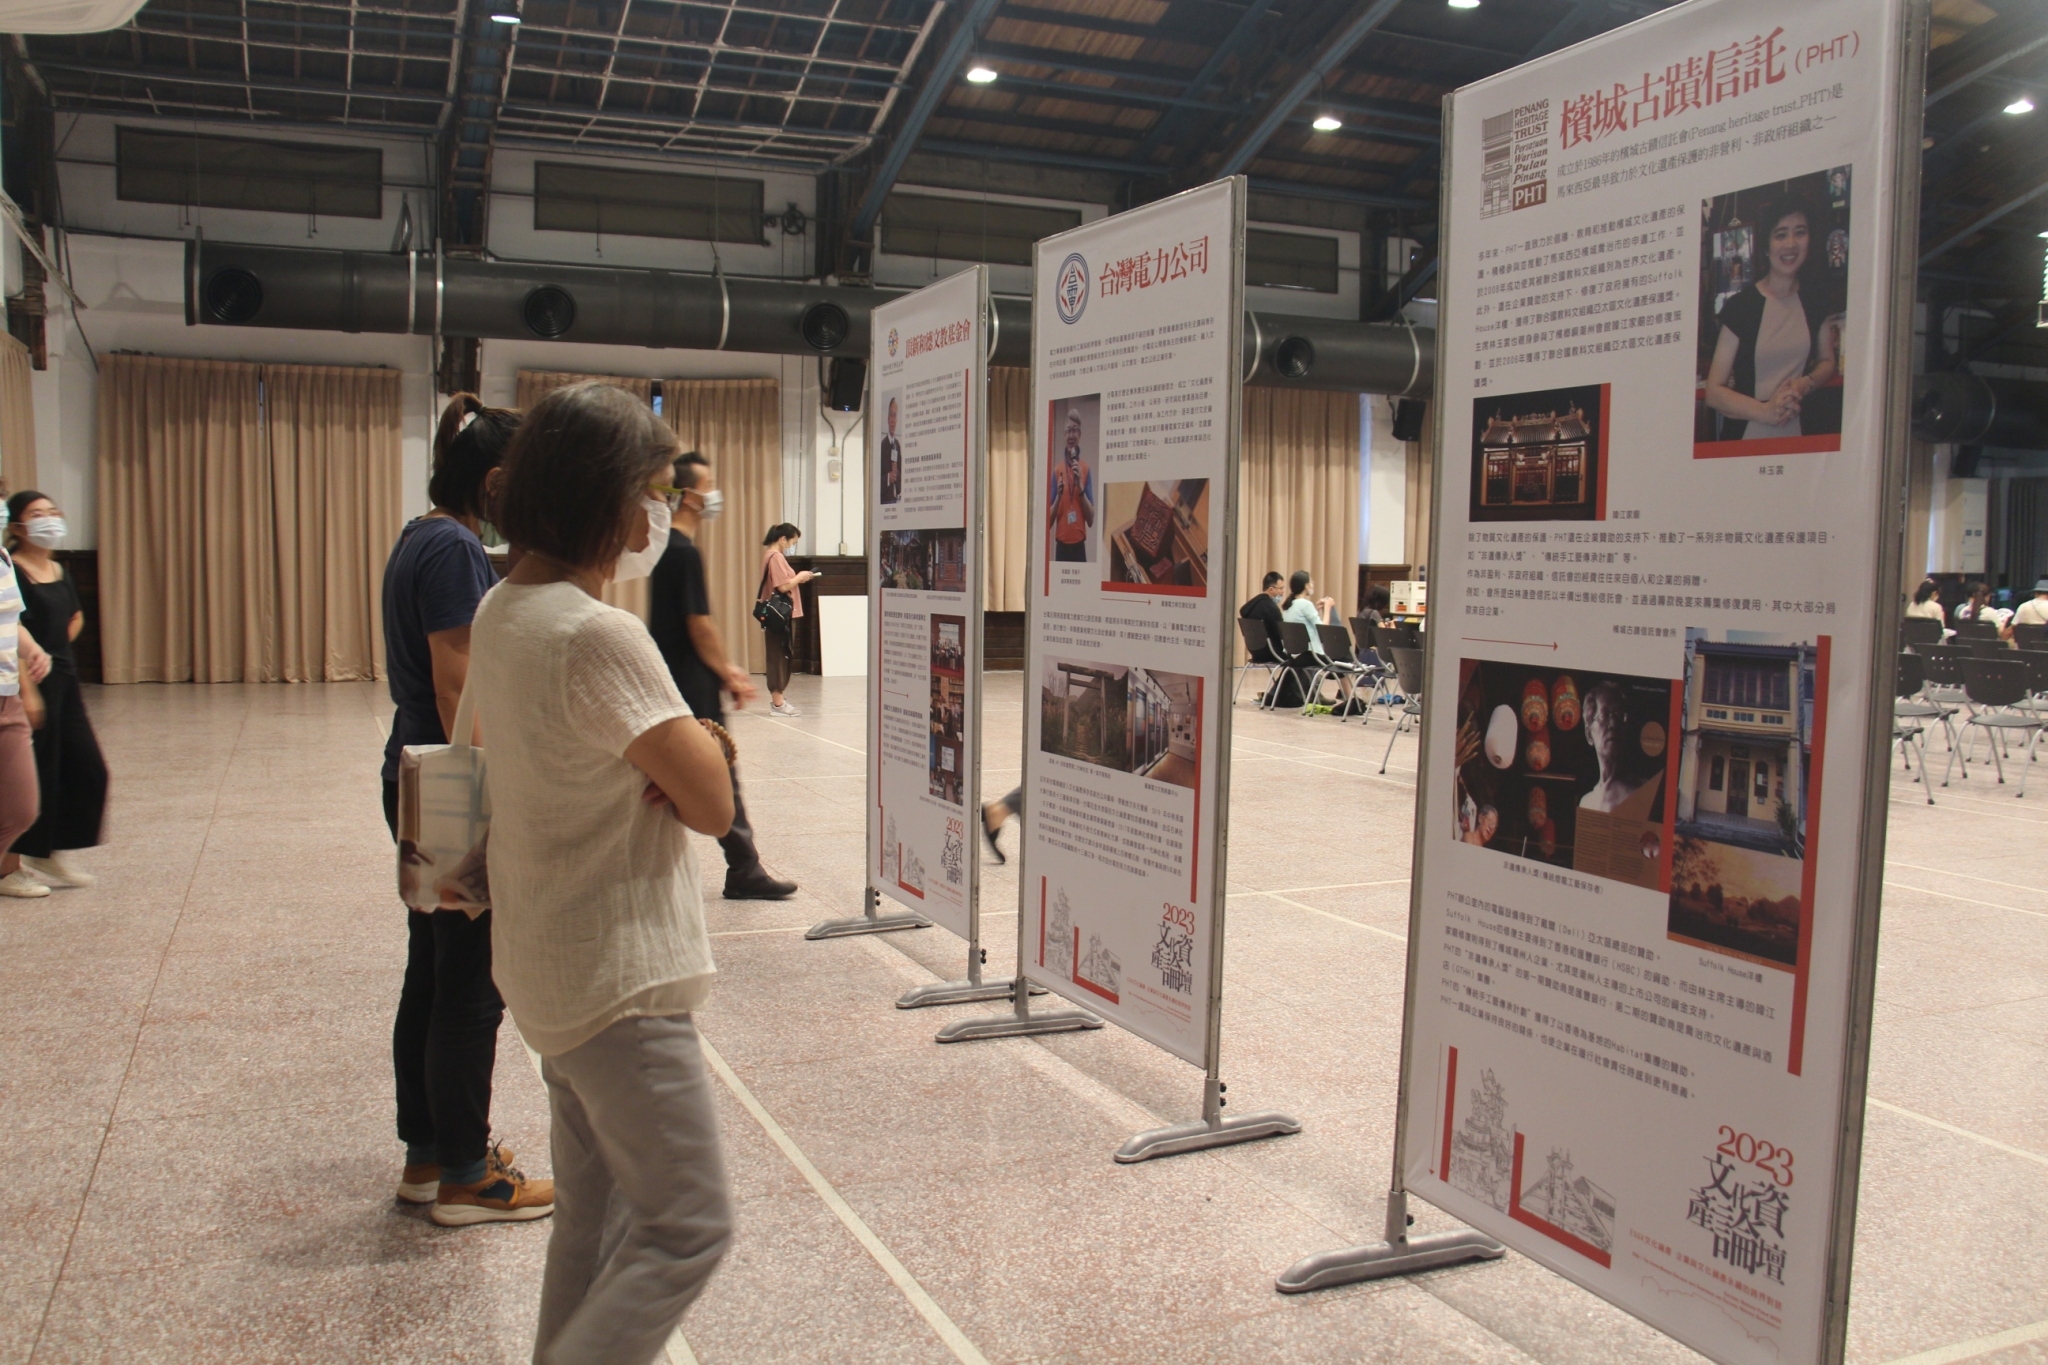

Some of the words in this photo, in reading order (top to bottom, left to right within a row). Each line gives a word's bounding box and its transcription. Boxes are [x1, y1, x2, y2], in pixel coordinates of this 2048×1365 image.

[1514, 98, 1548, 119] PENANG
[1728, 105, 1769, 131] heritage
[1514, 110, 1548, 129] HERITAGE
[1514, 120, 1548, 140] TRUST
[1514, 135, 1547, 154] Persatuan
[1514, 145, 1547, 164] Warisan
[1513, 155, 1547, 175] Pulau
[1512, 166, 1546, 186] Pinang
[1515, 183, 1544, 207] PHT
[1098, 233, 1208, 300] 台灣電力公司
[946, 815, 963, 840] 2023
[1162, 901, 1194, 936] 2023
[1717, 1125, 1794, 1188] 2023
